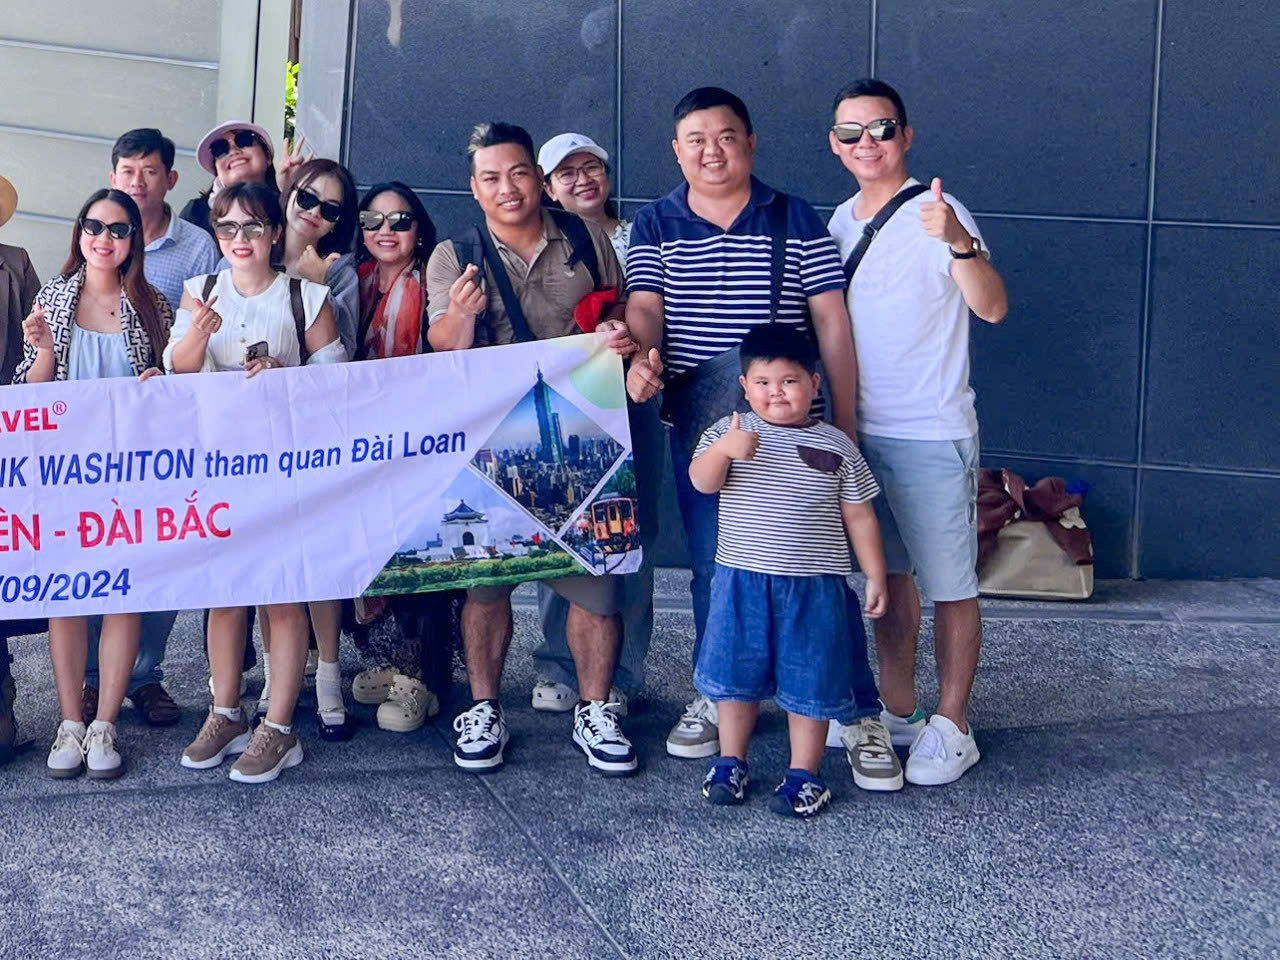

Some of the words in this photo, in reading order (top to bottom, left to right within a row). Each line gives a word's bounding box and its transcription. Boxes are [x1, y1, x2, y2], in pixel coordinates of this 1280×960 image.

[38, 448, 196, 486] WASHITON
[205, 449, 268, 478] tham
[278, 446, 341, 478] quan
[351, 433, 393, 463] Đài
[403, 431, 466, 458] Loan
[77, 498, 142, 548] ĐÀI
[156, 490, 232, 542] BẮC
